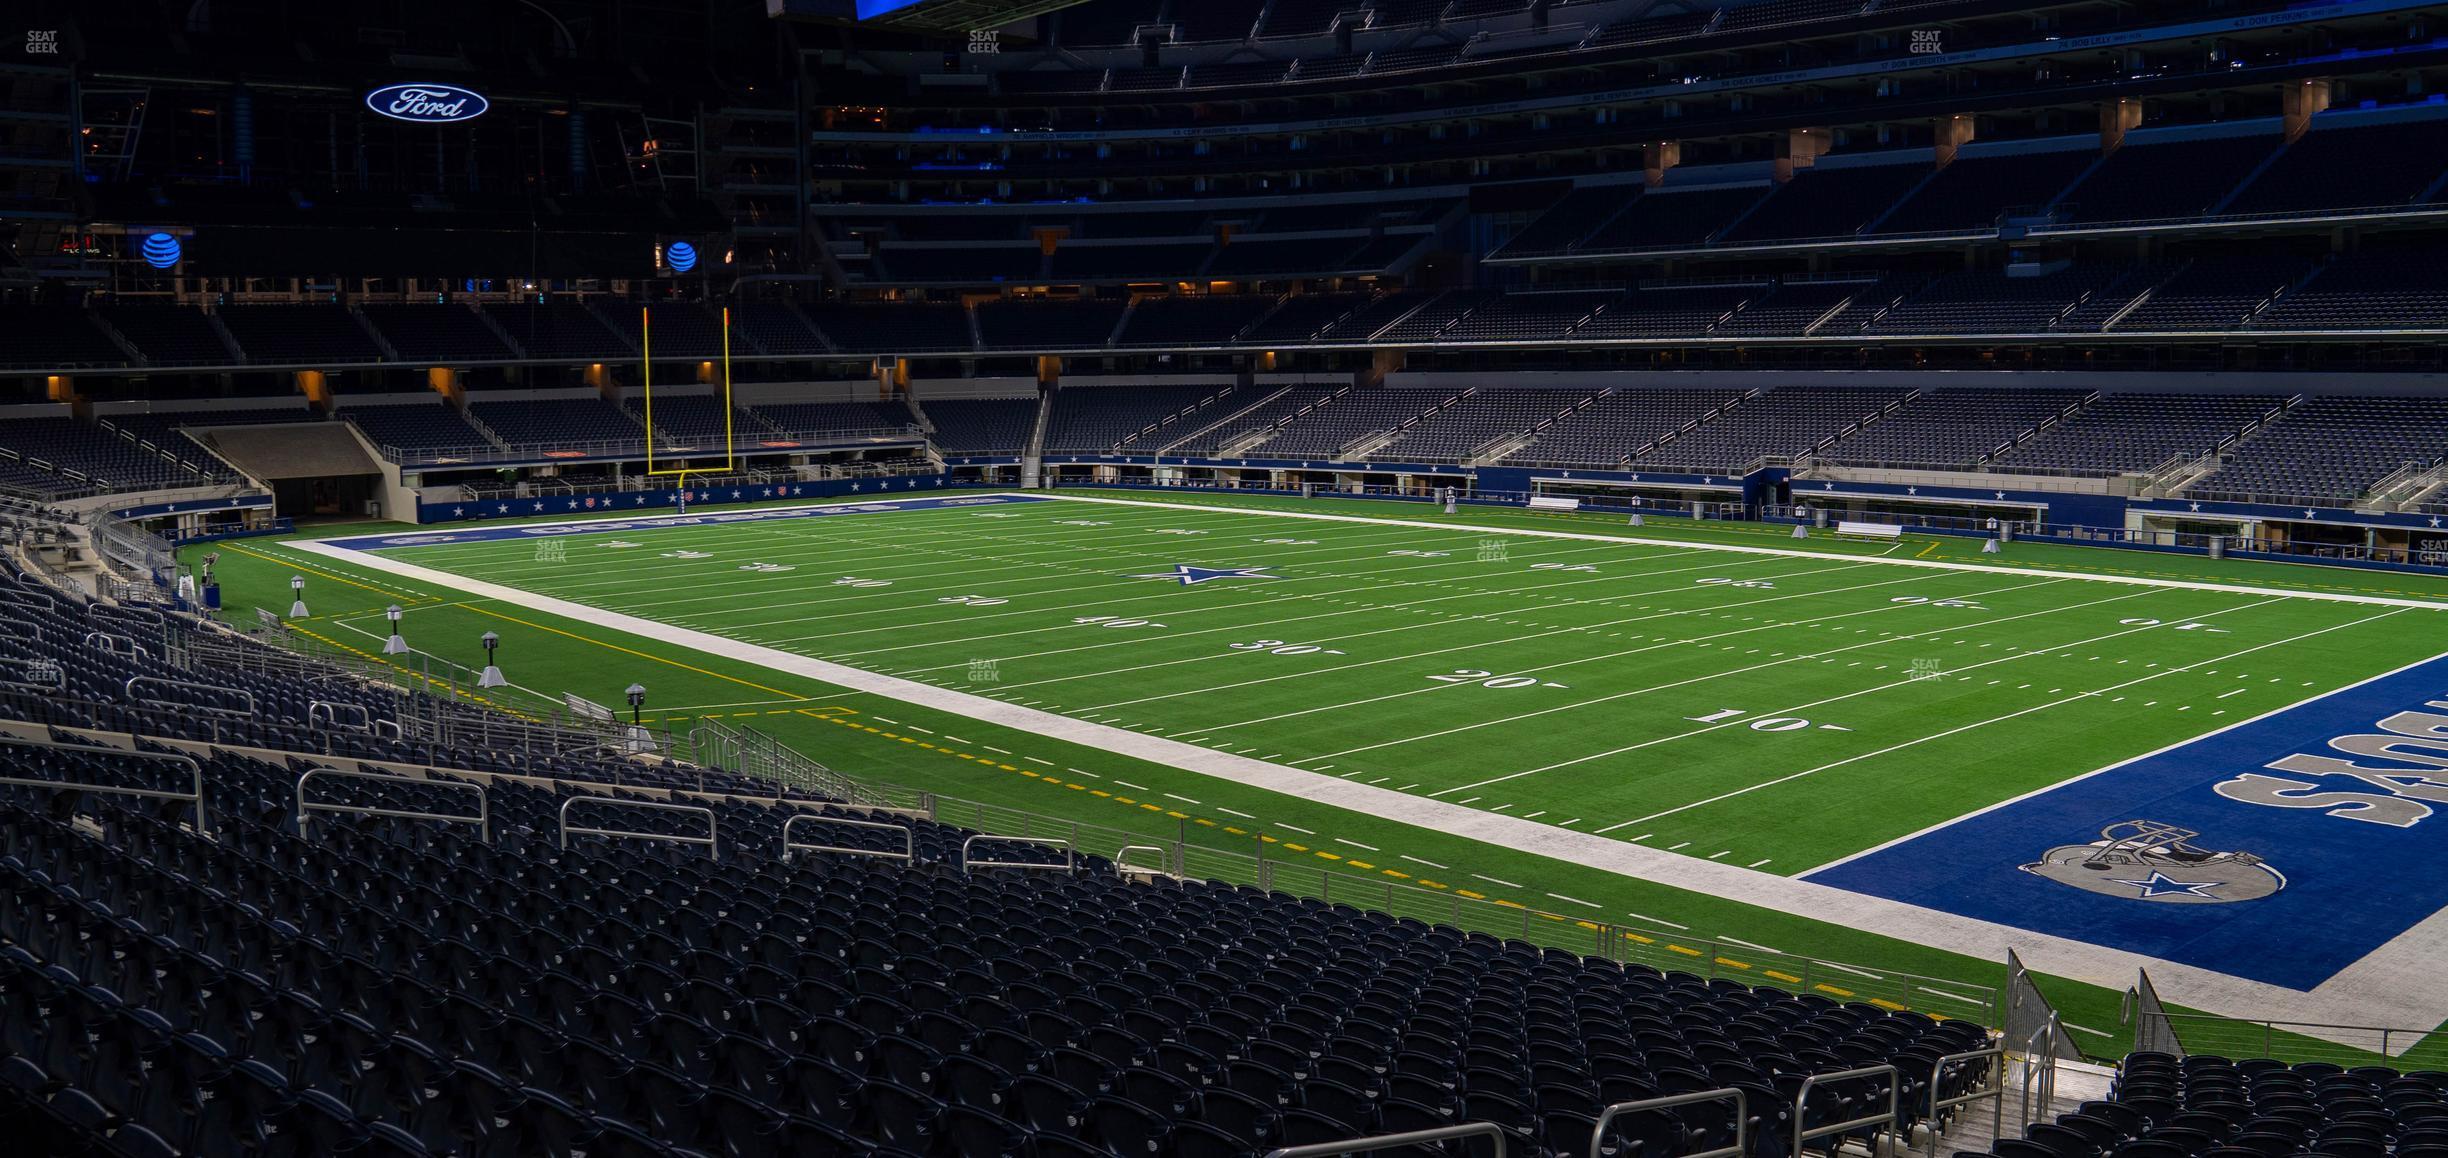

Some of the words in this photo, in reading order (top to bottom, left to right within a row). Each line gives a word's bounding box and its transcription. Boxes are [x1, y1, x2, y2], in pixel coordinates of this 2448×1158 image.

[389, 88, 468, 117] Ford
[1070, 616, 1149, 628] 40
[1229, 639, 1323, 655] 30
[1424, 669, 1539, 689] 20
[1682, 708, 1810, 732] 10
